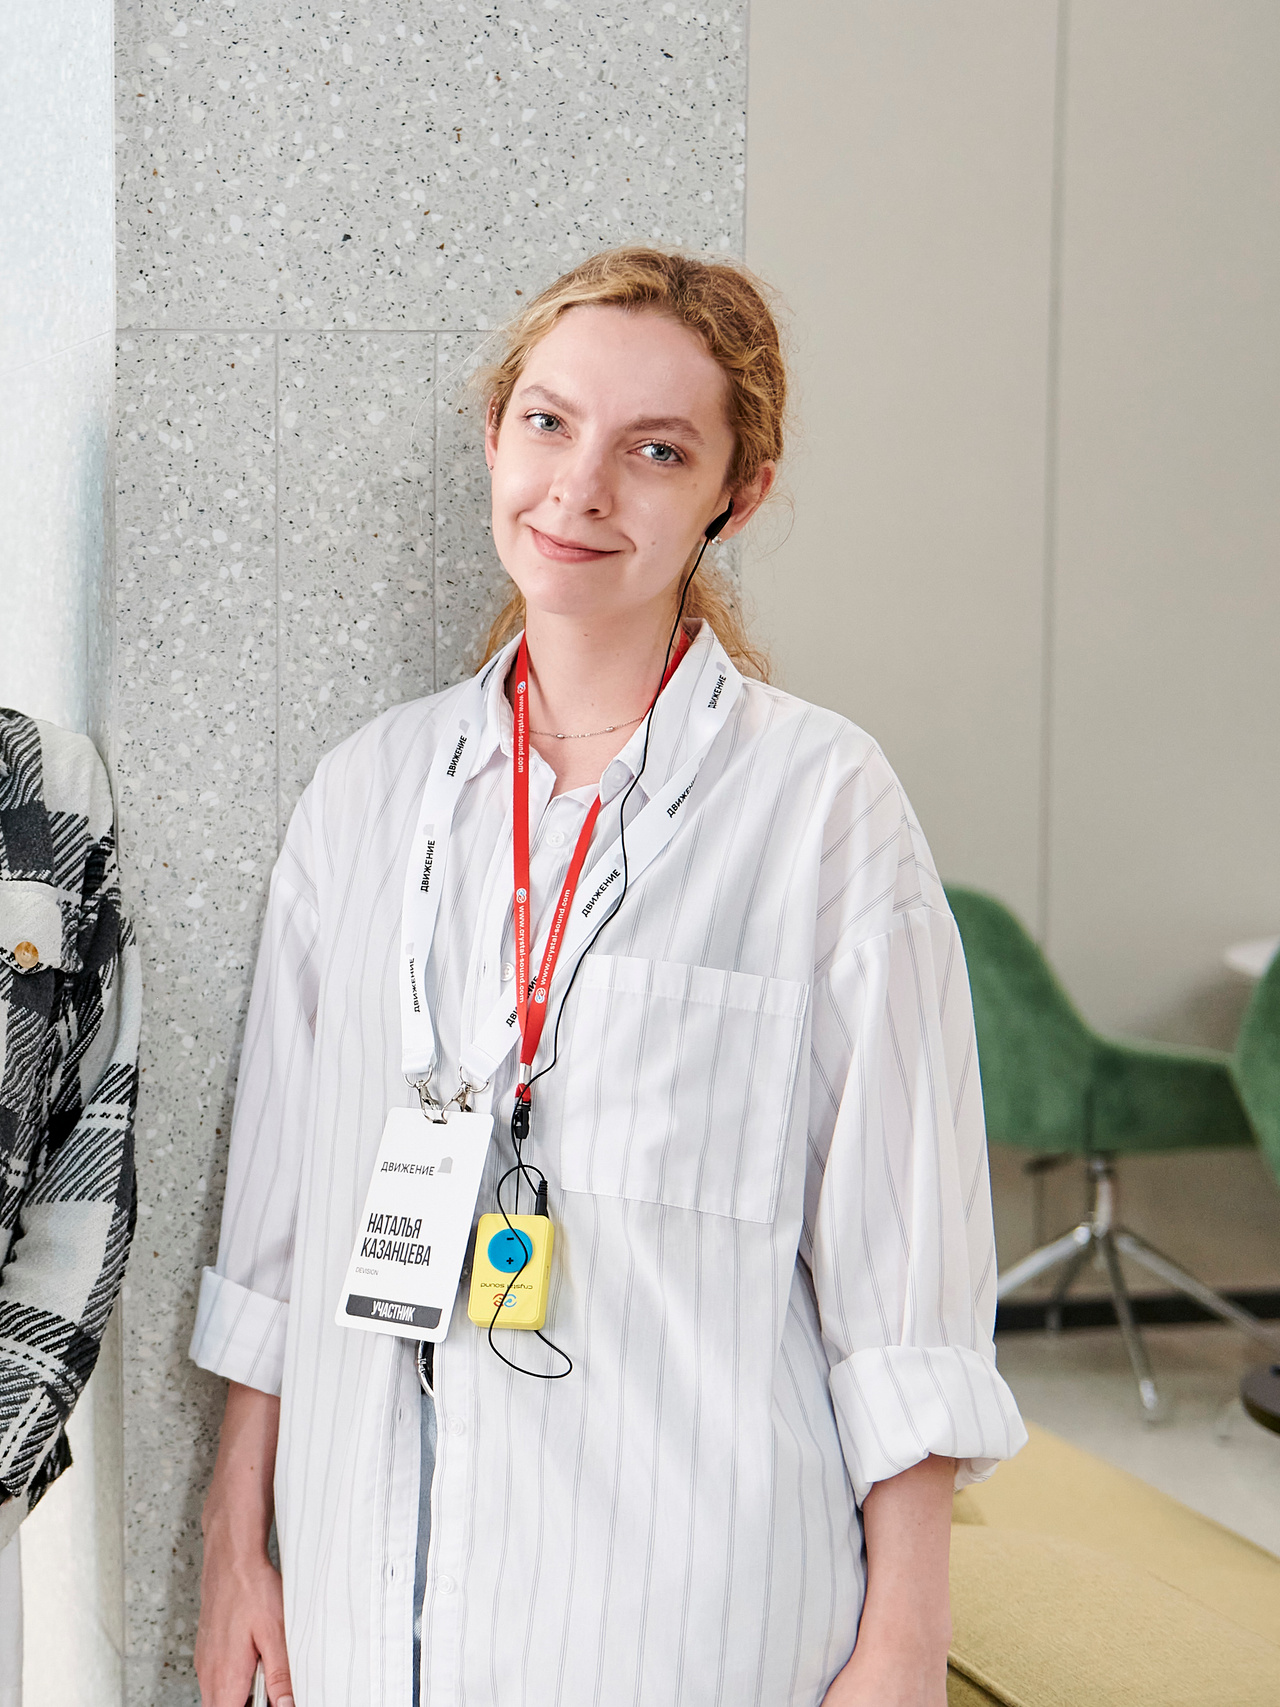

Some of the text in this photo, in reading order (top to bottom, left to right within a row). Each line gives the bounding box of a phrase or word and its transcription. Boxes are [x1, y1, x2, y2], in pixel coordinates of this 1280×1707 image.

[447, 735, 468, 777] ДВИЖЕНИЕ
[517, 695, 525, 773] www.crystal-sound.com
[420, 840, 436, 893] ДВИЖЕНИЕ
[581, 869, 621, 918] ДВИЖЕНИЕ
[518, 905, 526, 1004] www.crystal-sound.com
[540, 889, 571, 985] www.crystal-sound.com
[409, 957, 421, 1013] ДВИЖЕНИЕ
[381, 1161, 436, 1177] ДВИЖЕНИЕ
[367, 1212, 422, 1239] НАТАЛЬЯ
[355, 1266, 379, 1276] DEVISION
[360, 1237, 432, 1266] КАЗАНЦЕВА
[371, 1301, 416, 1322] УЧАСТНИК
